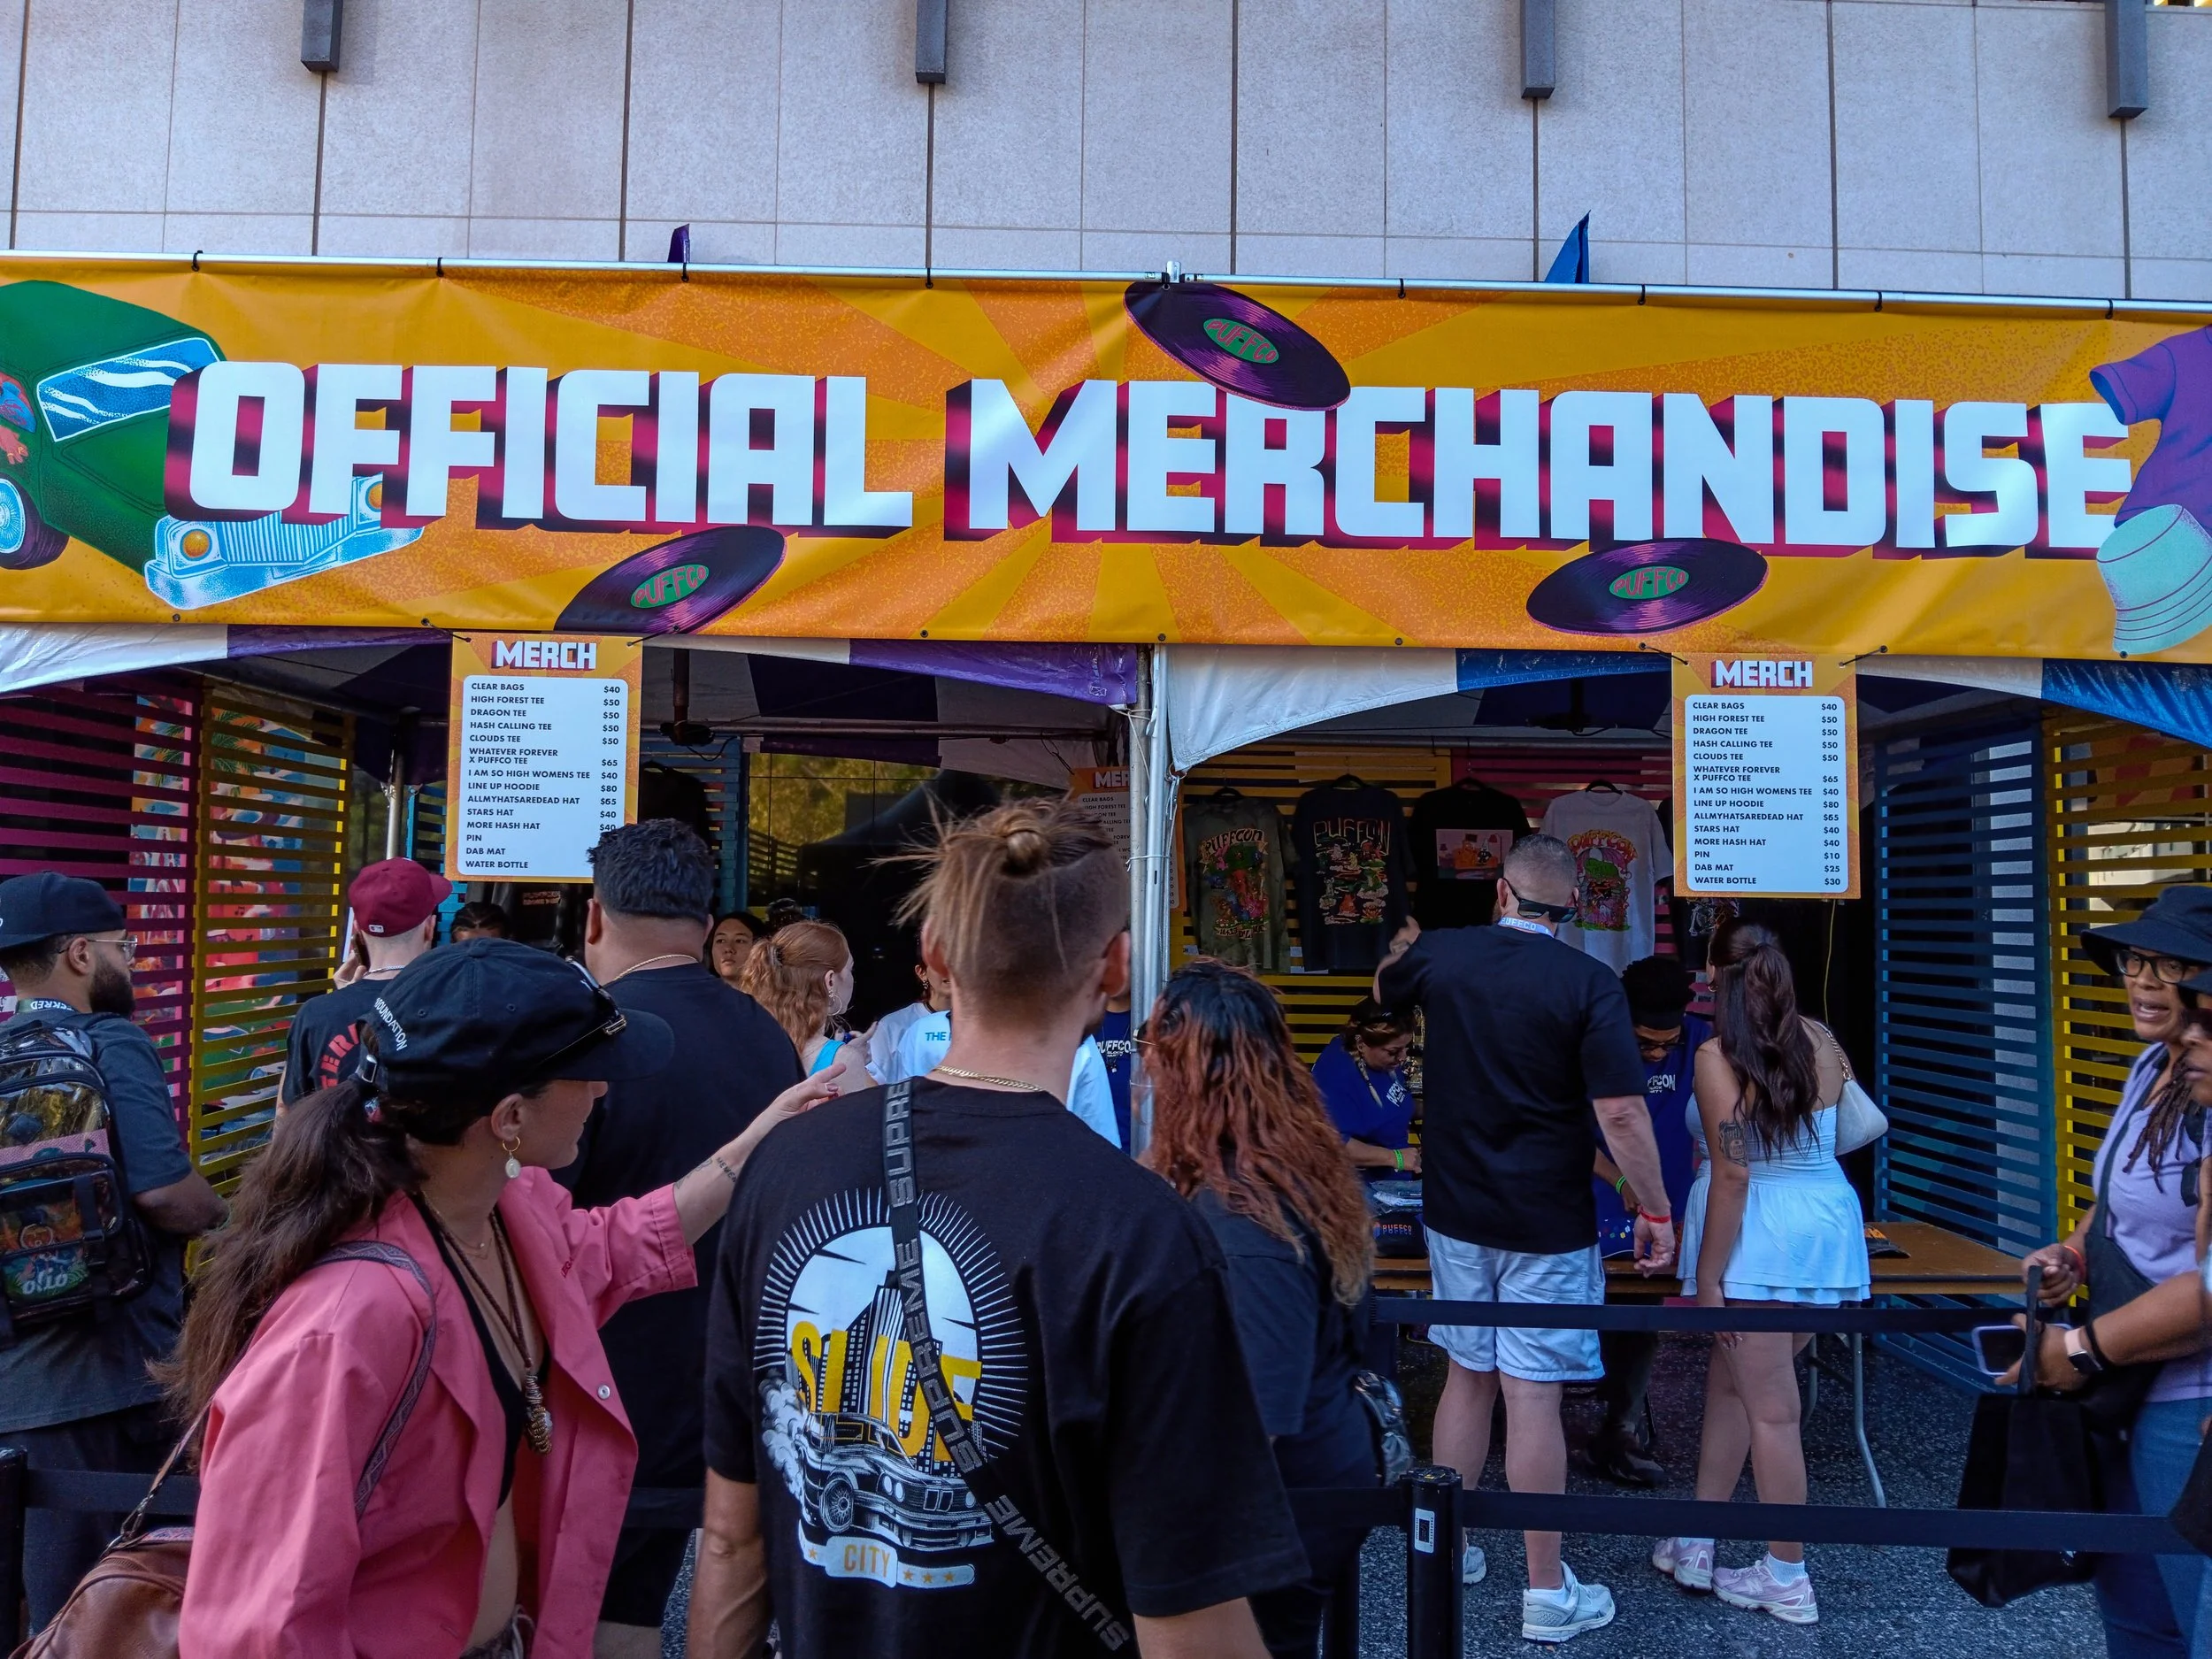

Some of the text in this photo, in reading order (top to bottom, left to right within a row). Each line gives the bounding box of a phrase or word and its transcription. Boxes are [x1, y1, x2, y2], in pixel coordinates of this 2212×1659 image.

[1207, 320, 1277, 361] PUFFCO
[179, 360, 2131, 553] OFFICIAL MERCHANDISE
[634, 565, 706, 606] PUFFCO
[1614, 568, 1686, 596] PUFFCO
[493, 641, 596, 671] MERCH
[1713, 660, 1813, 688] MERCH
[1094, 771, 1130, 788] MER
[467, 795, 560, 804] ALLMYHATSAREDEAD
[925, 1032, 947, 1041] THE
[886, 1081, 915, 1208] SUPRE
[896, 1236, 984, 1476] SUPREME
[843, 1544, 892, 1578] CITY
[986, 1493, 1131, 1652] SUPREME
